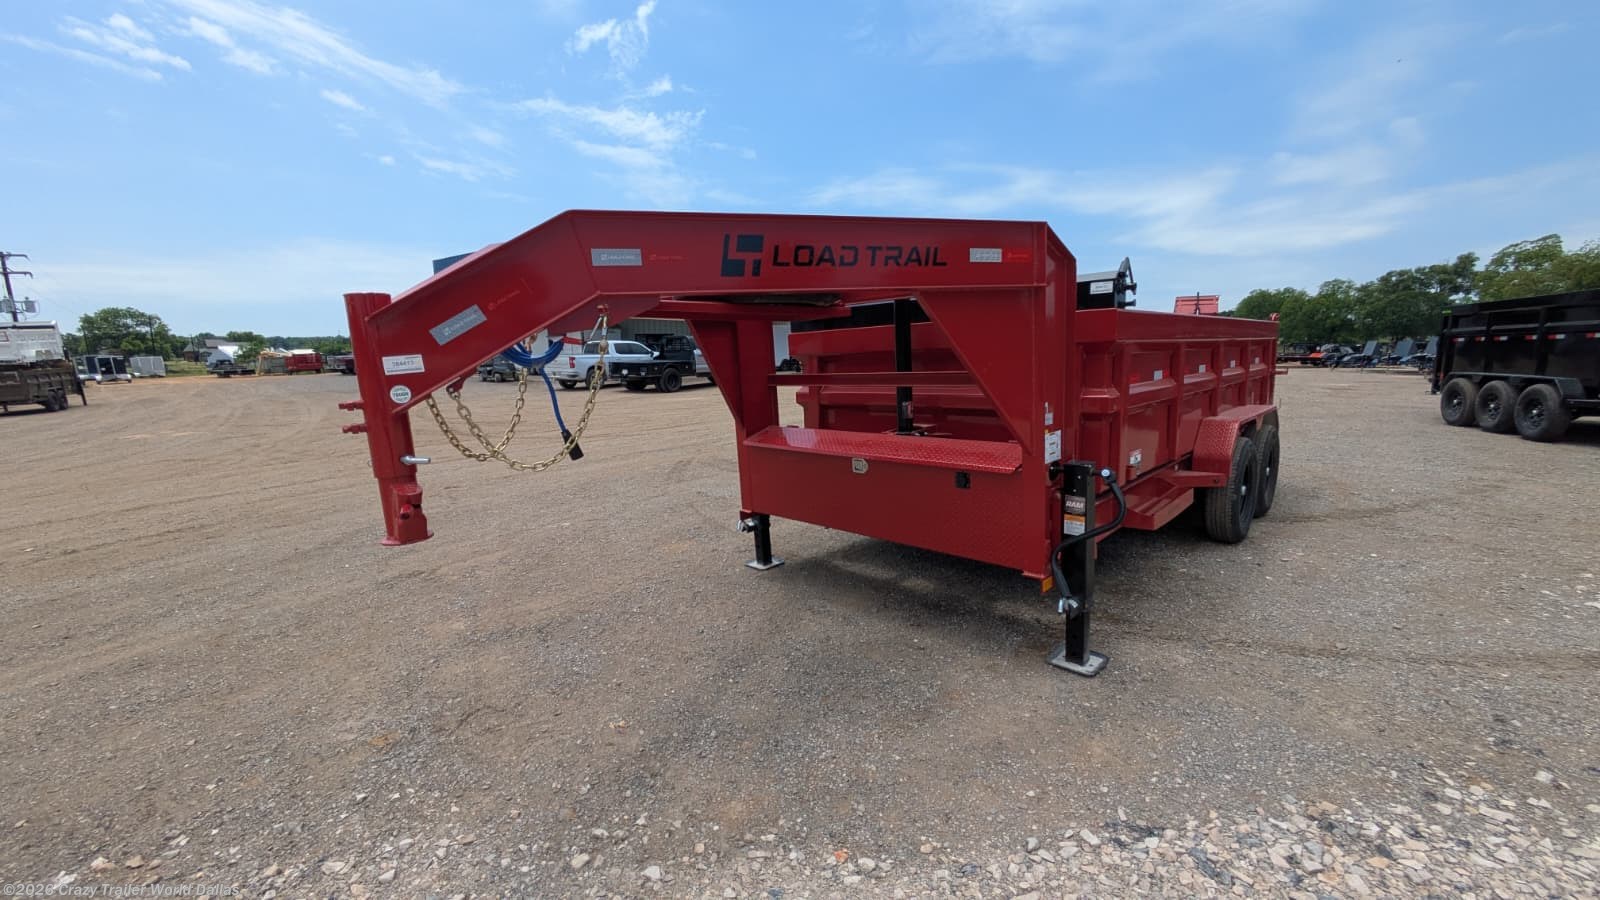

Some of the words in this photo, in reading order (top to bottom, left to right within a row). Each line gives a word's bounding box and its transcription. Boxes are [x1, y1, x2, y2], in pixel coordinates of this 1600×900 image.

[772, 244, 859, 267] LOAD
[866, 245, 948, 267] TRAIL
[1065, 501, 1084, 509] RAM
